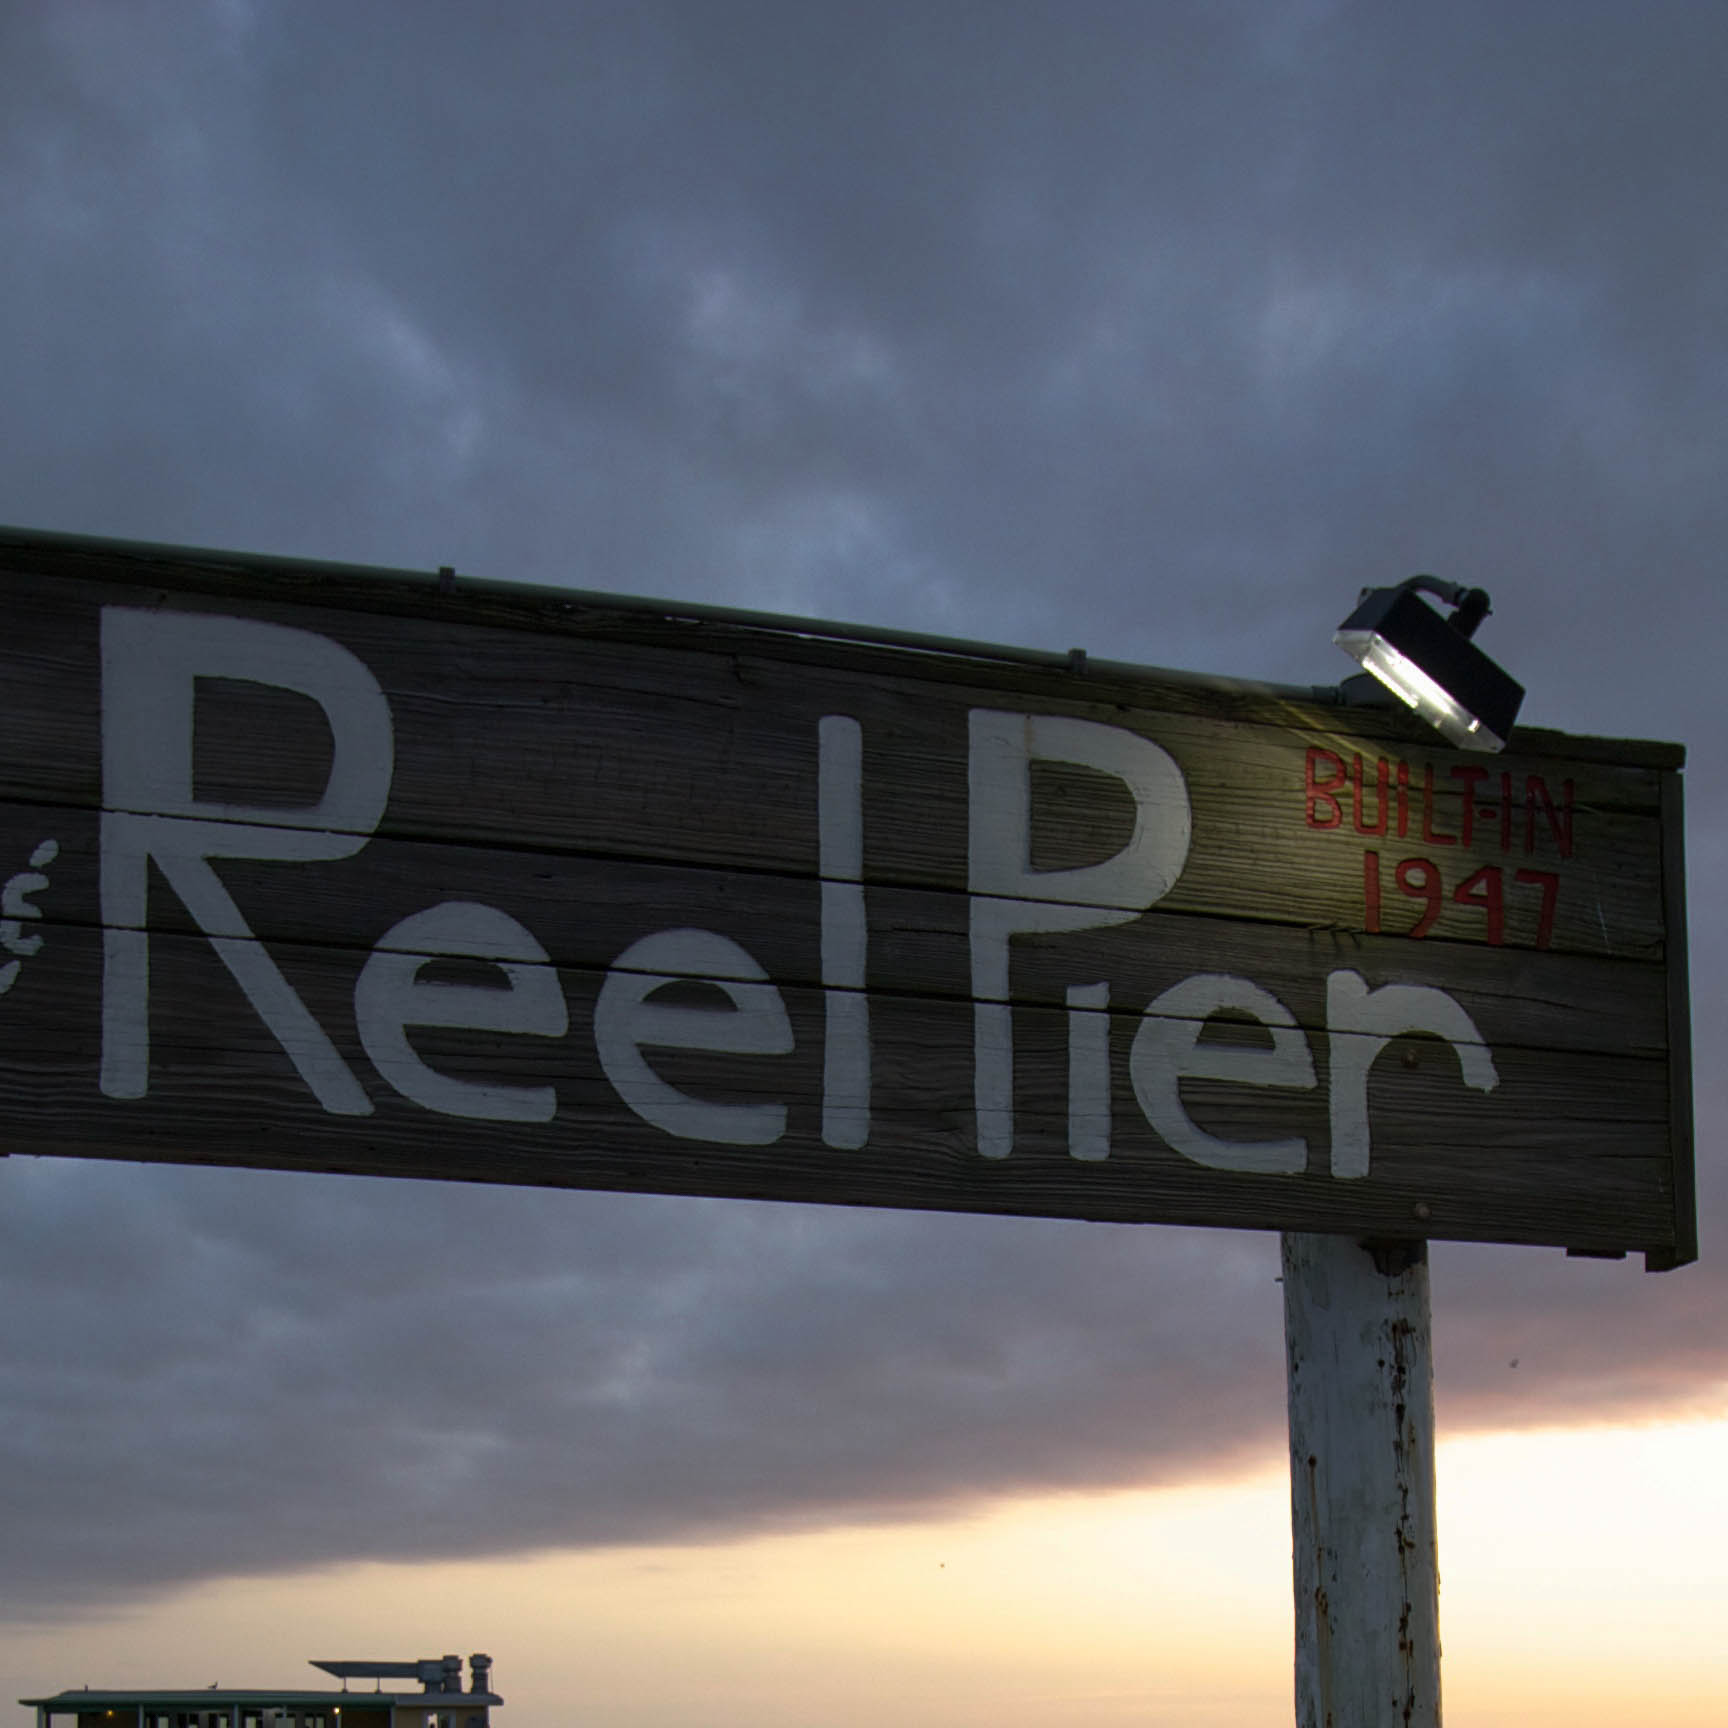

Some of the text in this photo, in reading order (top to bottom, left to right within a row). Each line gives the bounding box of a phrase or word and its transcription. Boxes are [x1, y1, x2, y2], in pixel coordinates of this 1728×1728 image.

[99, 605, 868, 1150] Reel
[967, 708, 1500, 1179] Pier
[1363, 850, 1560, 950] 1947
